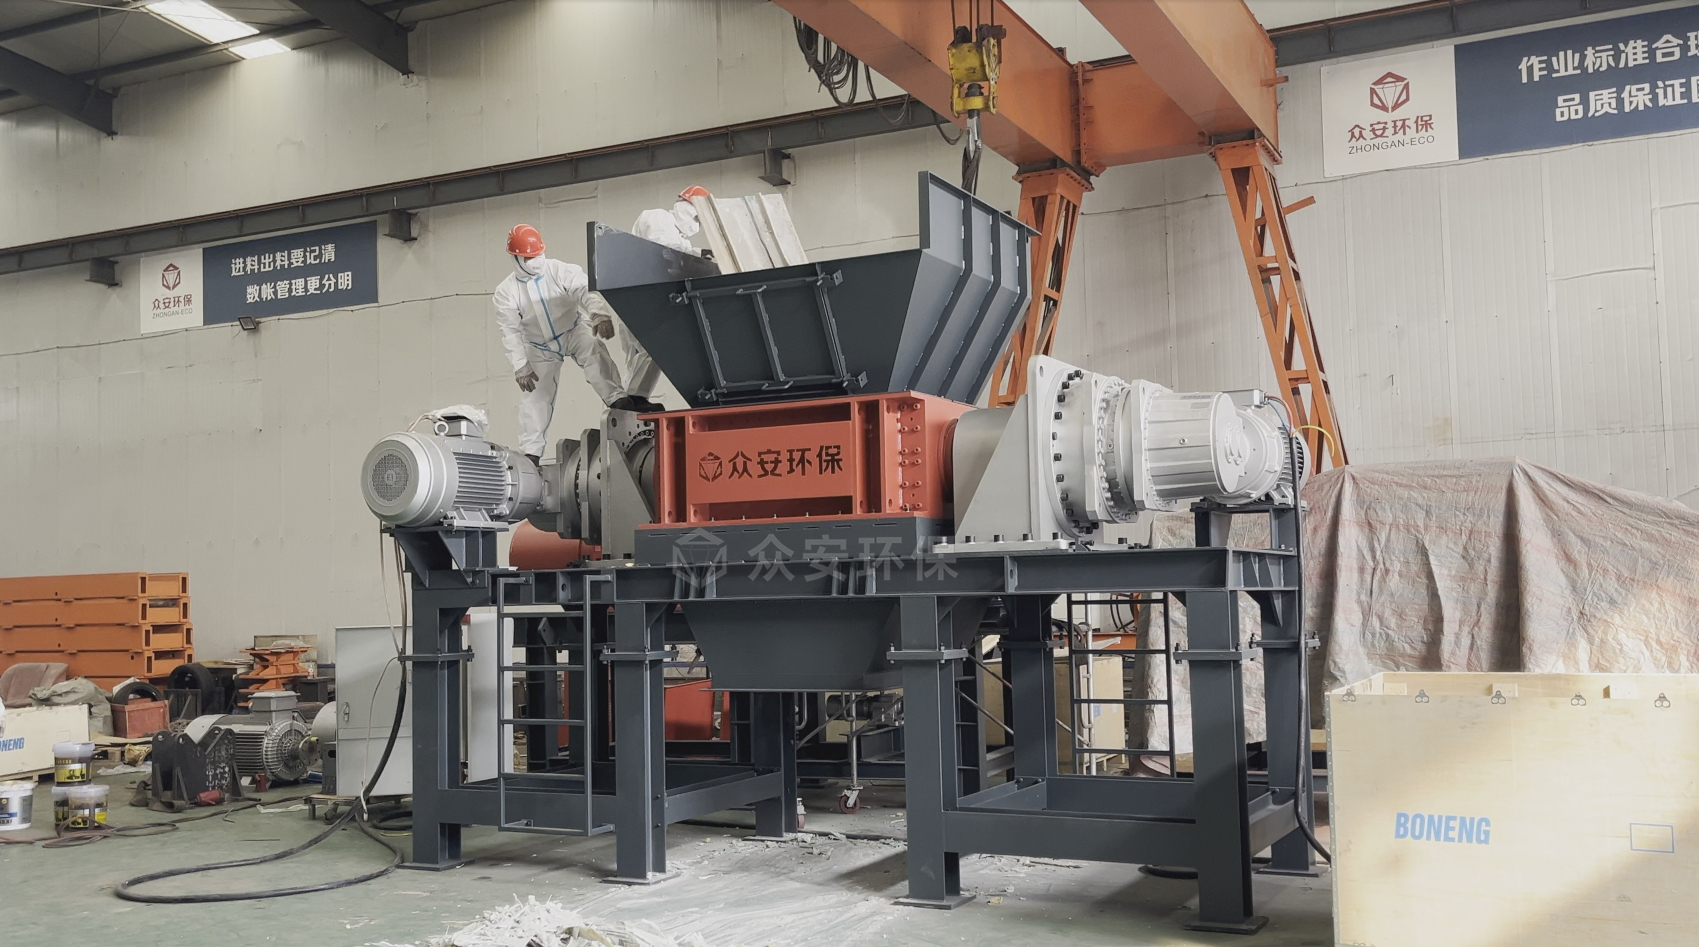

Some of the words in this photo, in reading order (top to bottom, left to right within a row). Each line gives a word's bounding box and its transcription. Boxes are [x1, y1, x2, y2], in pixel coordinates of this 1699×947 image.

[1348, 114, 1434, 143] 众安环保
[1348, 135, 1435, 155] ZHONGAN-ECO
[231, 243, 336, 277] 进料出料要记清
[246, 271, 352, 303] 数帐管理更分明
[152, 294, 192, 311] 众安环保
[728, 445, 843, 480] 众安环保
[0, 737, 25, 752] NENG
[1395, 812, 1491, 845] BONENG
